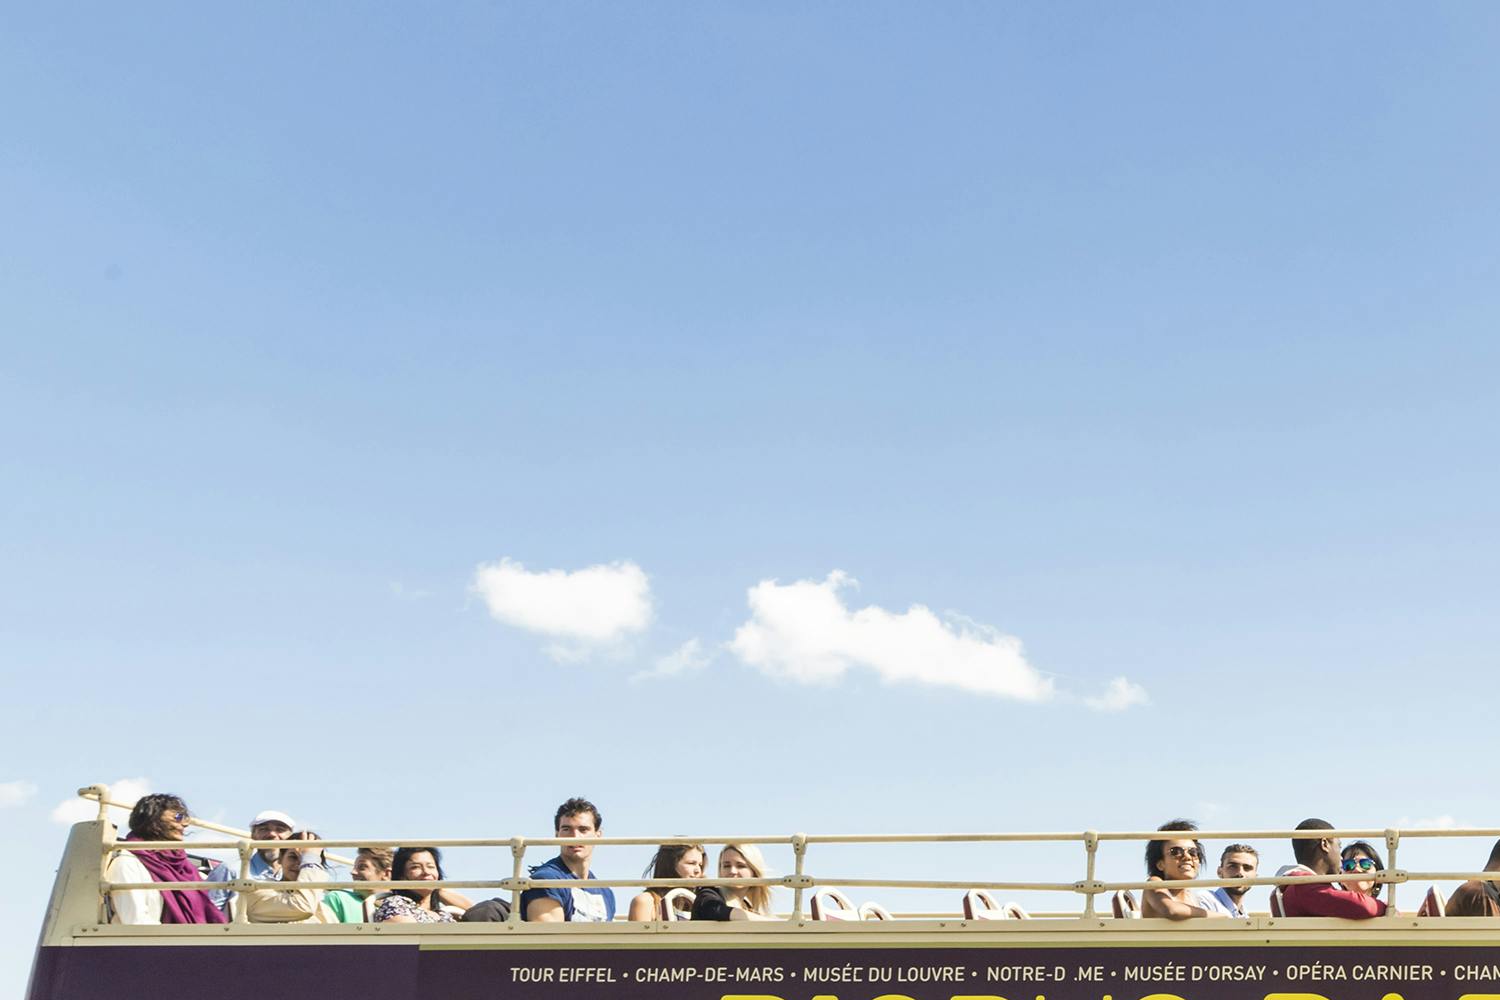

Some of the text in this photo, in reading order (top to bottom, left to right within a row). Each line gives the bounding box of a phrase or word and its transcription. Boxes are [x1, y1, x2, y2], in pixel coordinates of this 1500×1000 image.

[510, 967, 554, 982] TOUR
[559, 967, 617, 982] EIFFEL
[635, 967, 784, 982] CHAMP-DE-MARS
[868, 967, 892, 982] DU
[897, 966, 965, 982] LOUVRE
[987, 966, 1104, 981] NOTRE-DME
[1124, 961, 1186, 981] MUSÉE
[1191, 965, 1266, 981] D'ORSAY
[1286, 960, 1347, 980] OPÉRA
